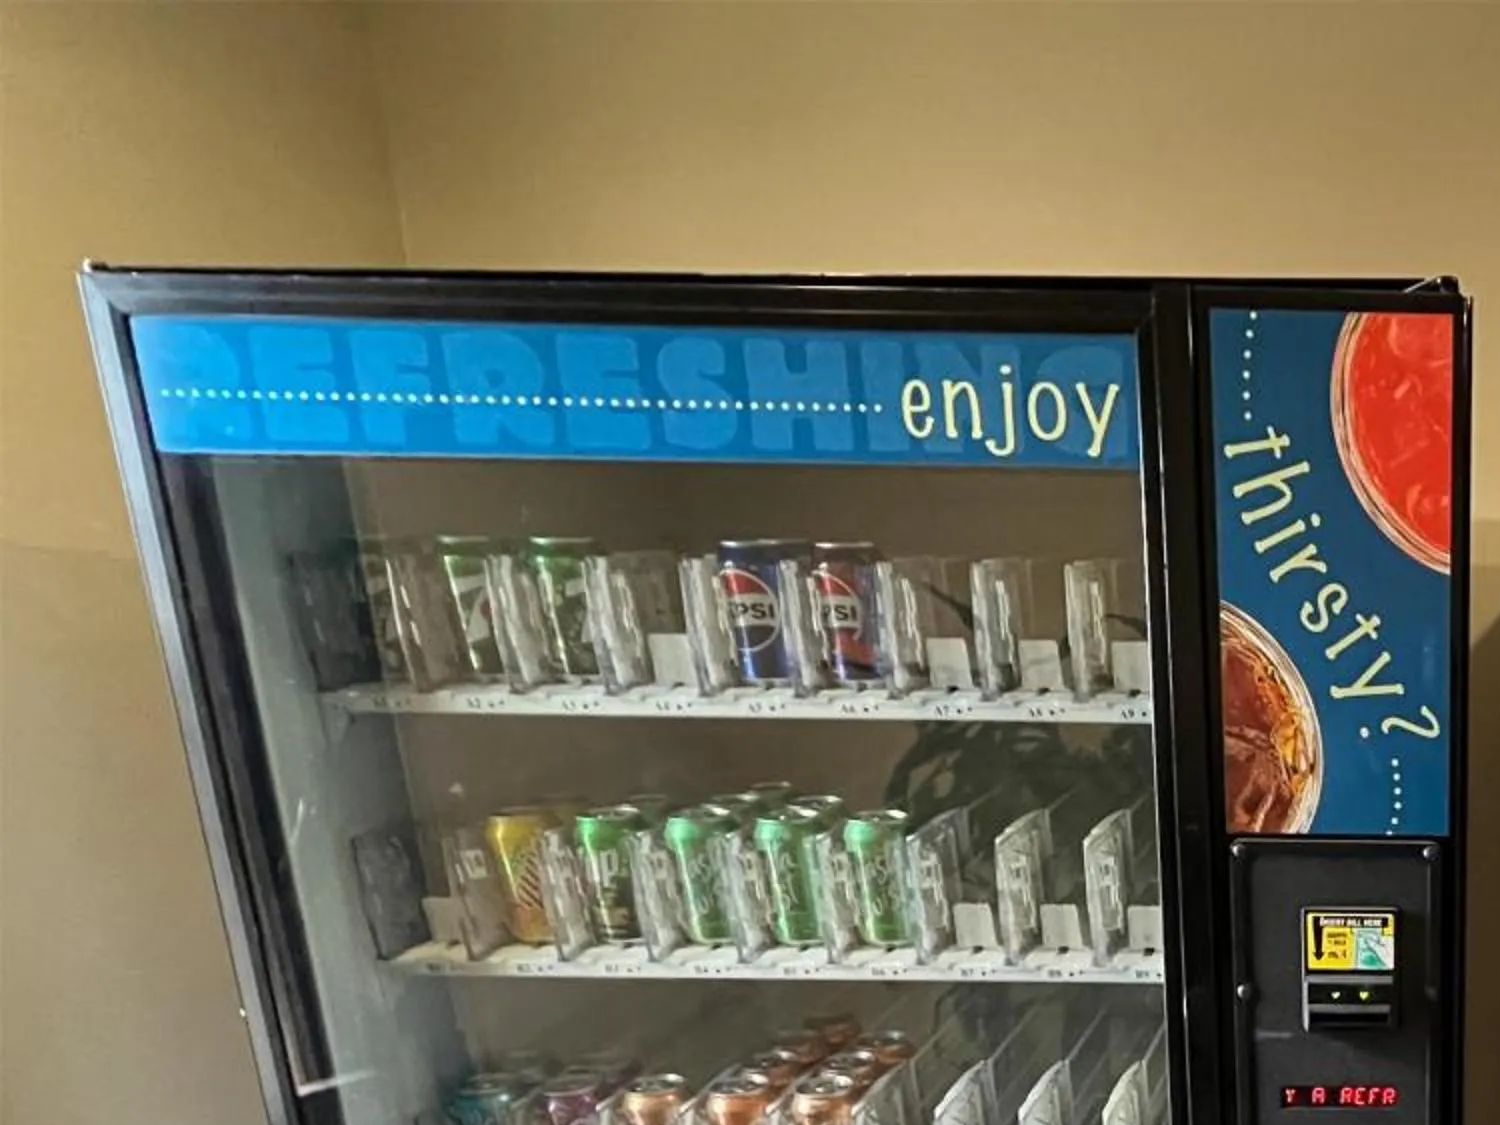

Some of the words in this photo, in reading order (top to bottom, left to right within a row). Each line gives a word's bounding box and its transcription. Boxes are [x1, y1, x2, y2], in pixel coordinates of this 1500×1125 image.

[902, 364, 1120, 457] enjoy
[1224, 425, 1441, 742] thirsty?
[1311, 1087, 1325, 1104] A
